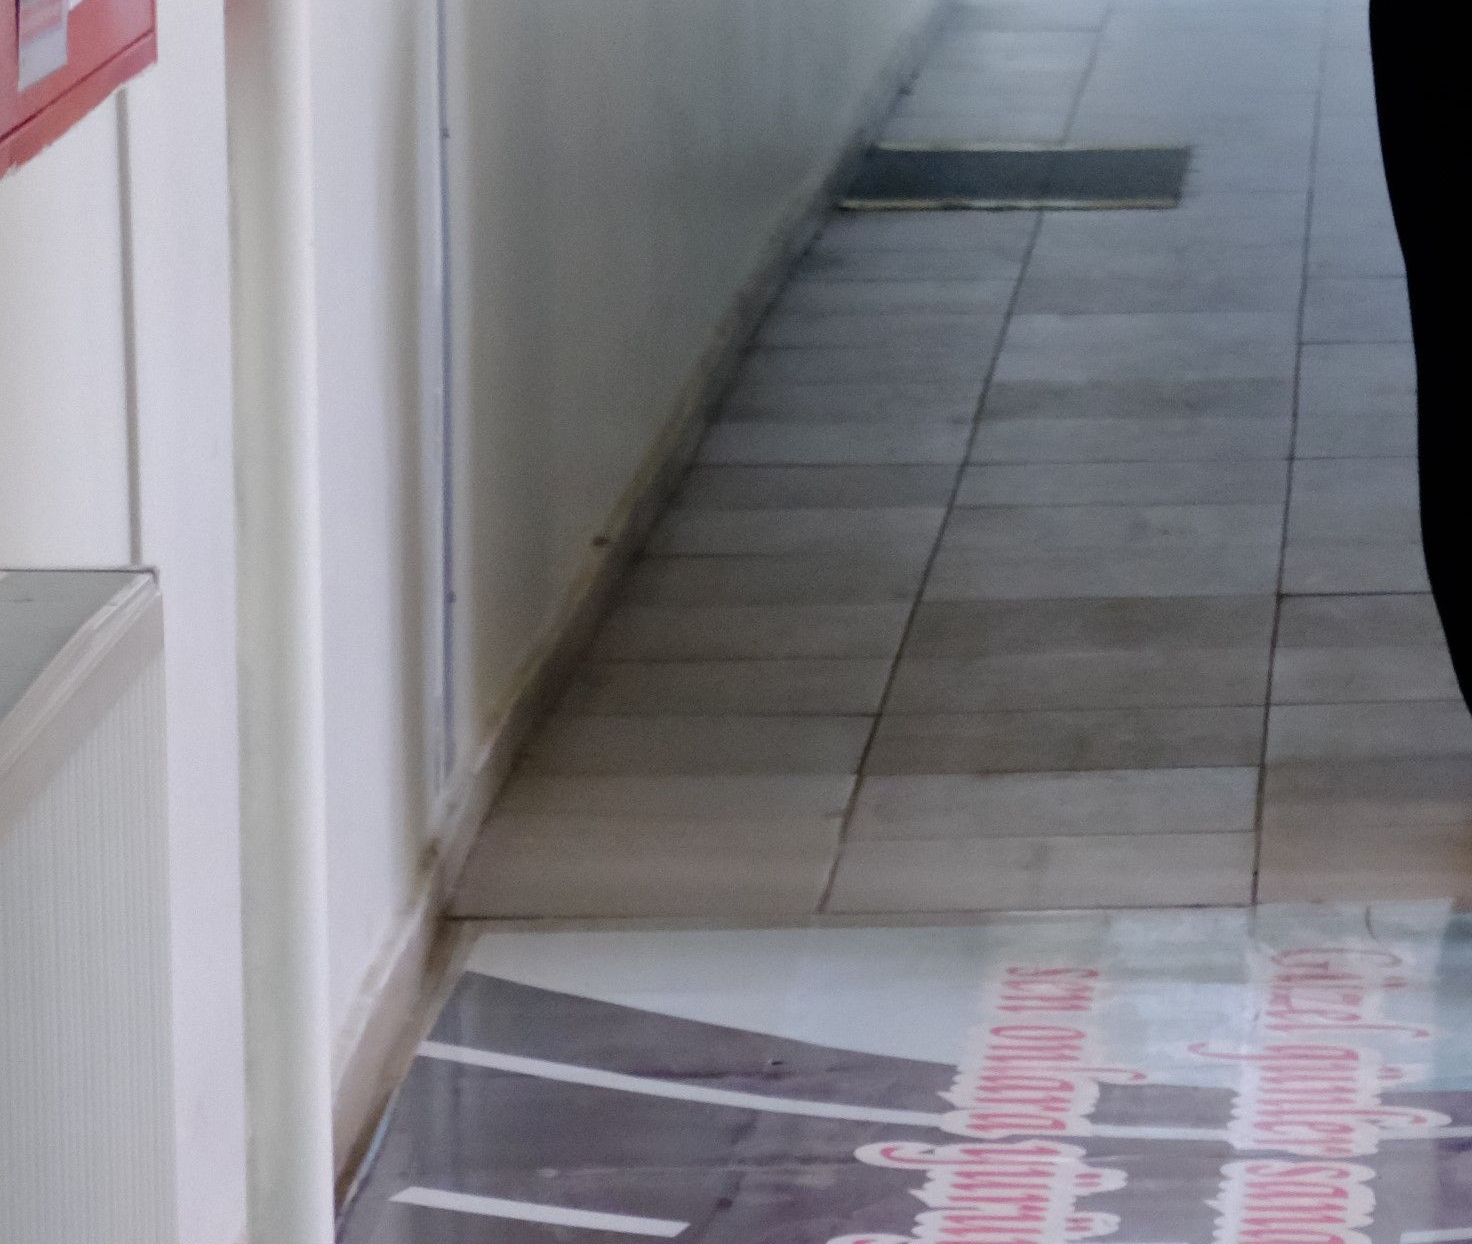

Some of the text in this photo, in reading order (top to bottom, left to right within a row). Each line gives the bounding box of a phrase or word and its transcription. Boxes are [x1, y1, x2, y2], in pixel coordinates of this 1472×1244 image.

[1264, 947, 1431, 1034] Güzel
[852, 966, 1148, 1244] sen onlara yürü
[1186, 1043, 1428, 1154] günler
